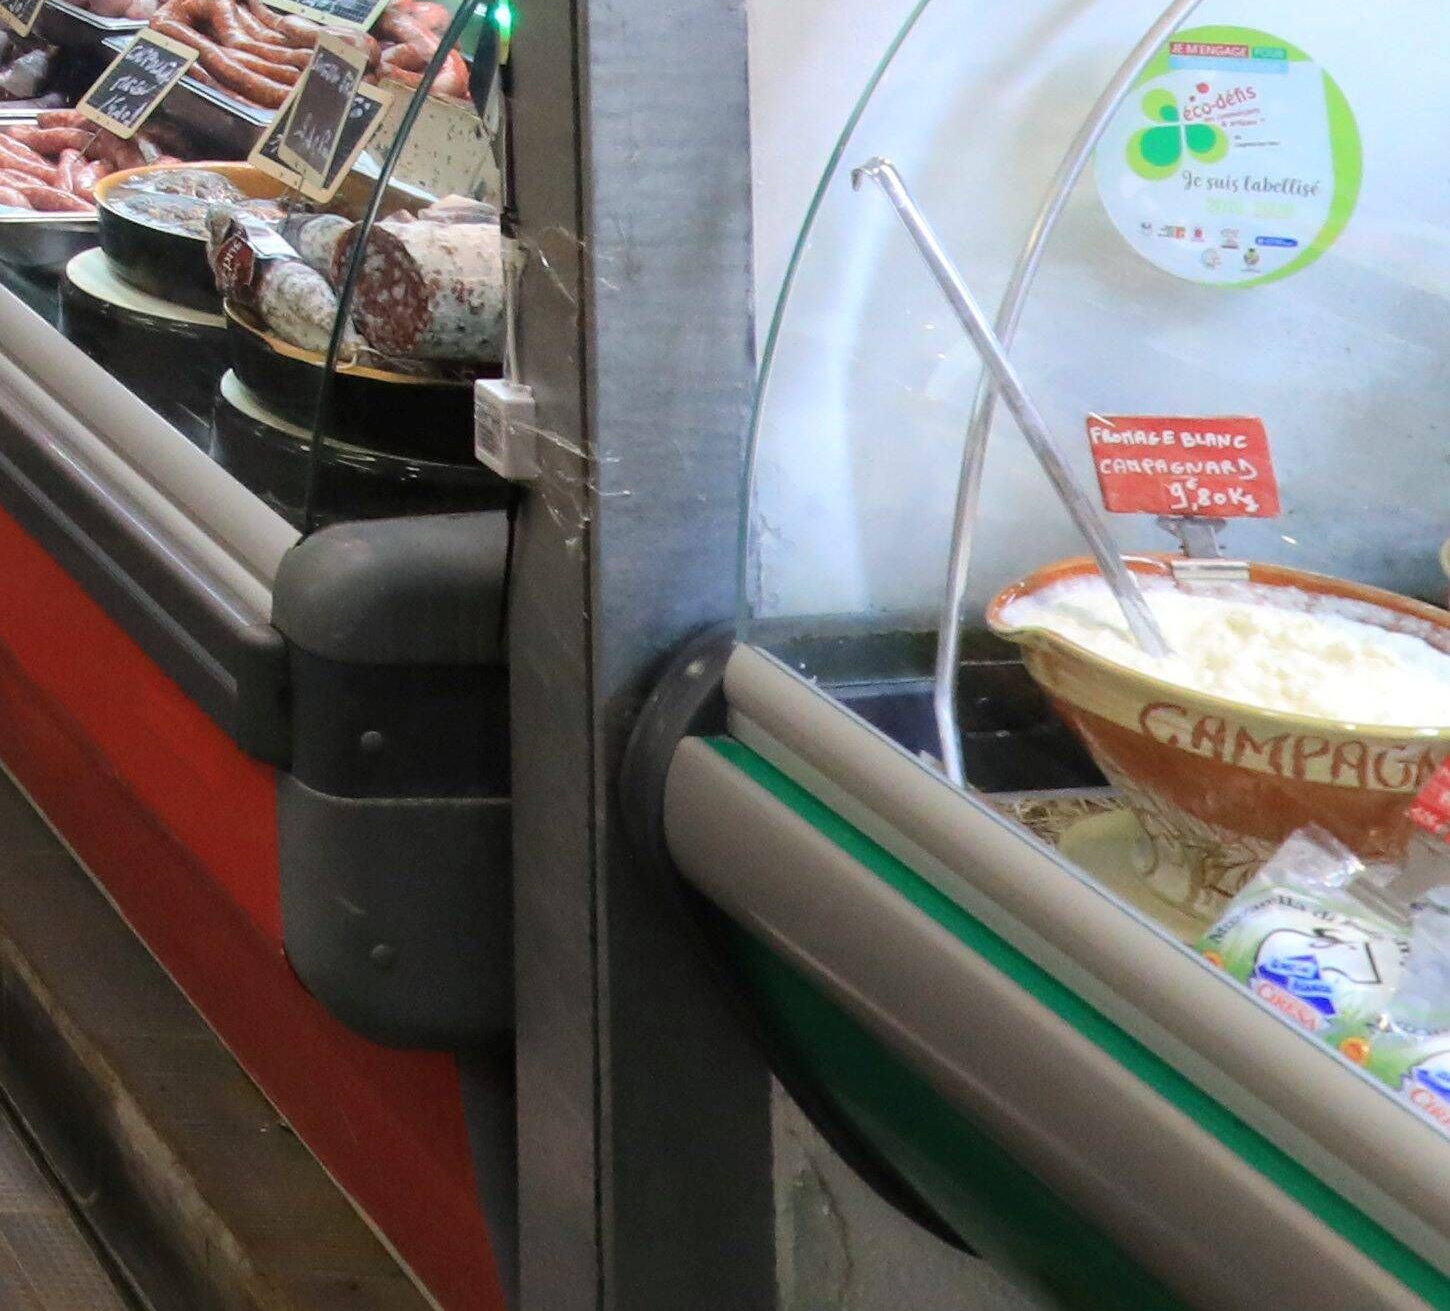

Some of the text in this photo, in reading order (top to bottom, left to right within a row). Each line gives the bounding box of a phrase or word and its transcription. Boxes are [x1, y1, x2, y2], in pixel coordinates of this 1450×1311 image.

[1182, 170, 1320, 198] Je suis labellisé
[1089, 426, 1248, 449] FROMAGE BLANC
[1099, 457, 1258, 481] CAMPAGNARD
